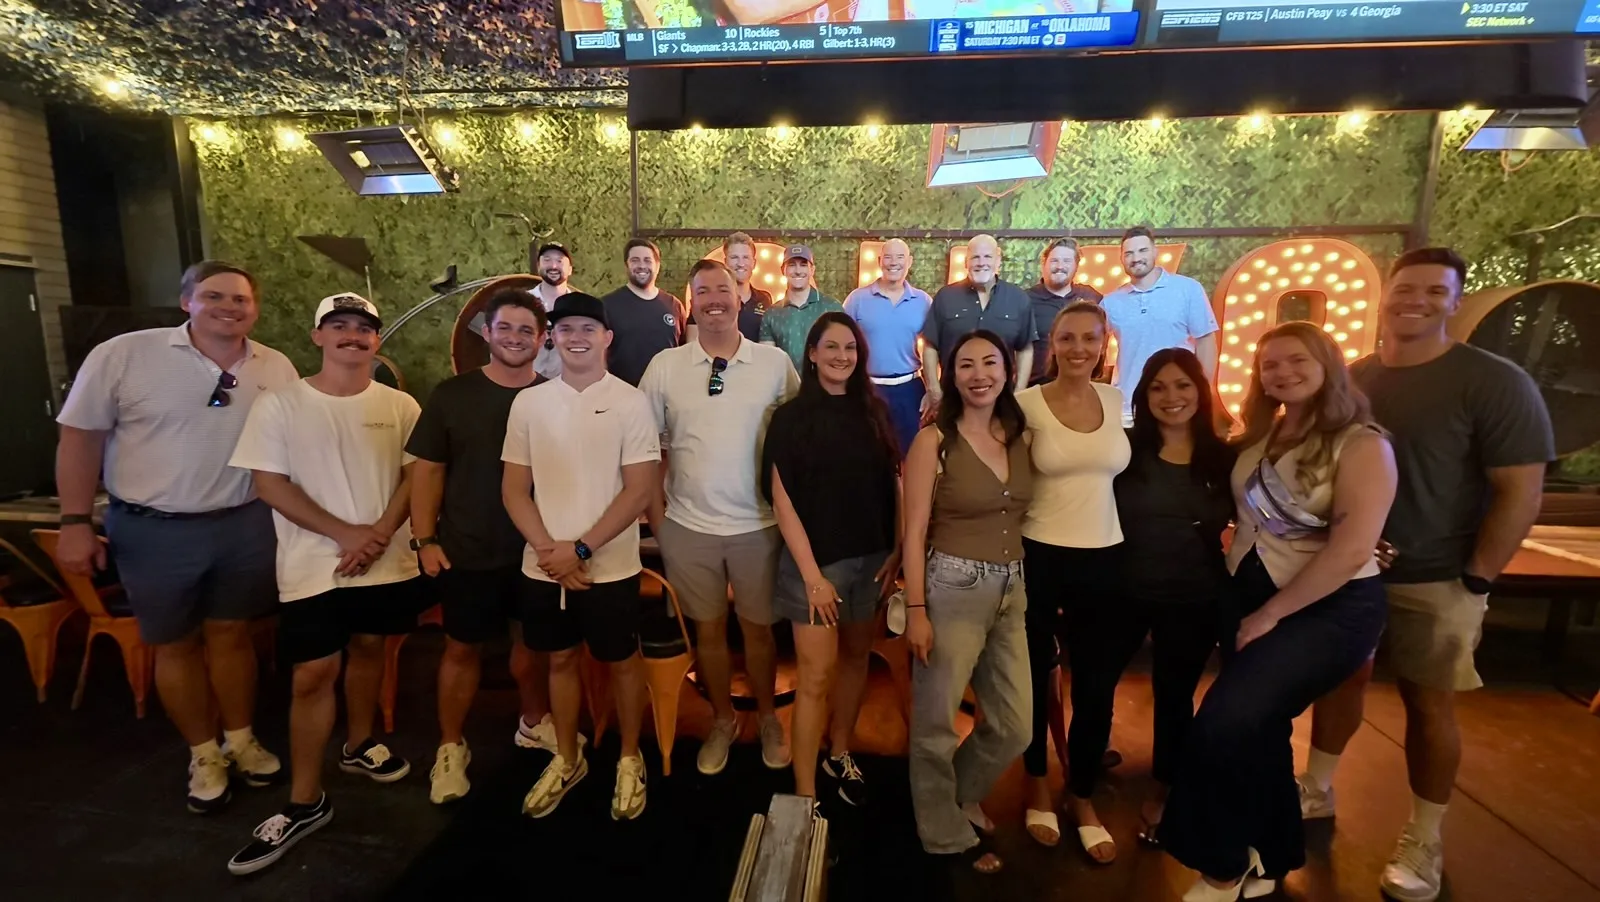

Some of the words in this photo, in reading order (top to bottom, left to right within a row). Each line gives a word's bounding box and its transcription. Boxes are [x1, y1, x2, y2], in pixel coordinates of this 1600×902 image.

[1226, 11, 1246, 21] CFB
[1246, 10, 1264, 20] T25
[1270, 8, 1305, 19] Austin
[1306, 7, 1334, 20] Peay
[1336, 8, 1348, 17] vs
[1350, 6, 1359, 17] 4
[1359, 4, 1402, 18] Georgia
[1470, 3, 1493, 14] 3:30
[1493, 3, 1508, 12] ET
[1508, 2, 1529, 12] SAT
[974, 20, 1029, 35] MICHIGAN
[1049, 16, 1111, 32] OKLAHOMA
[1466, 17, 1487, 27] SEC
[1486, 16, 1526, 26] Network
[626, 33, 645, 42] MLB
[656, 30, 687, 41] Giants
[725, 28, 738, 39] 10
[744, 27, 780, 38] Rockies
[819, 25, 828, 36] 5
[833, 26, 848, 37] Top
[849, 25, 863, 35] 7th
[658, 43, 669, 54] SF
[750, 41, 759, 51] 2
[792, 39, 800, 50] 4
[800, 39, 815, 49] RBI
[869, 36, 896, 48] HR(3)
[964, 36, 1002, 47] SATURDAY
[1001, 36, 1018, 46] 7:30
[1018, 36, 1031, 45] PM
[1031, 35, 1041, 45] ET
